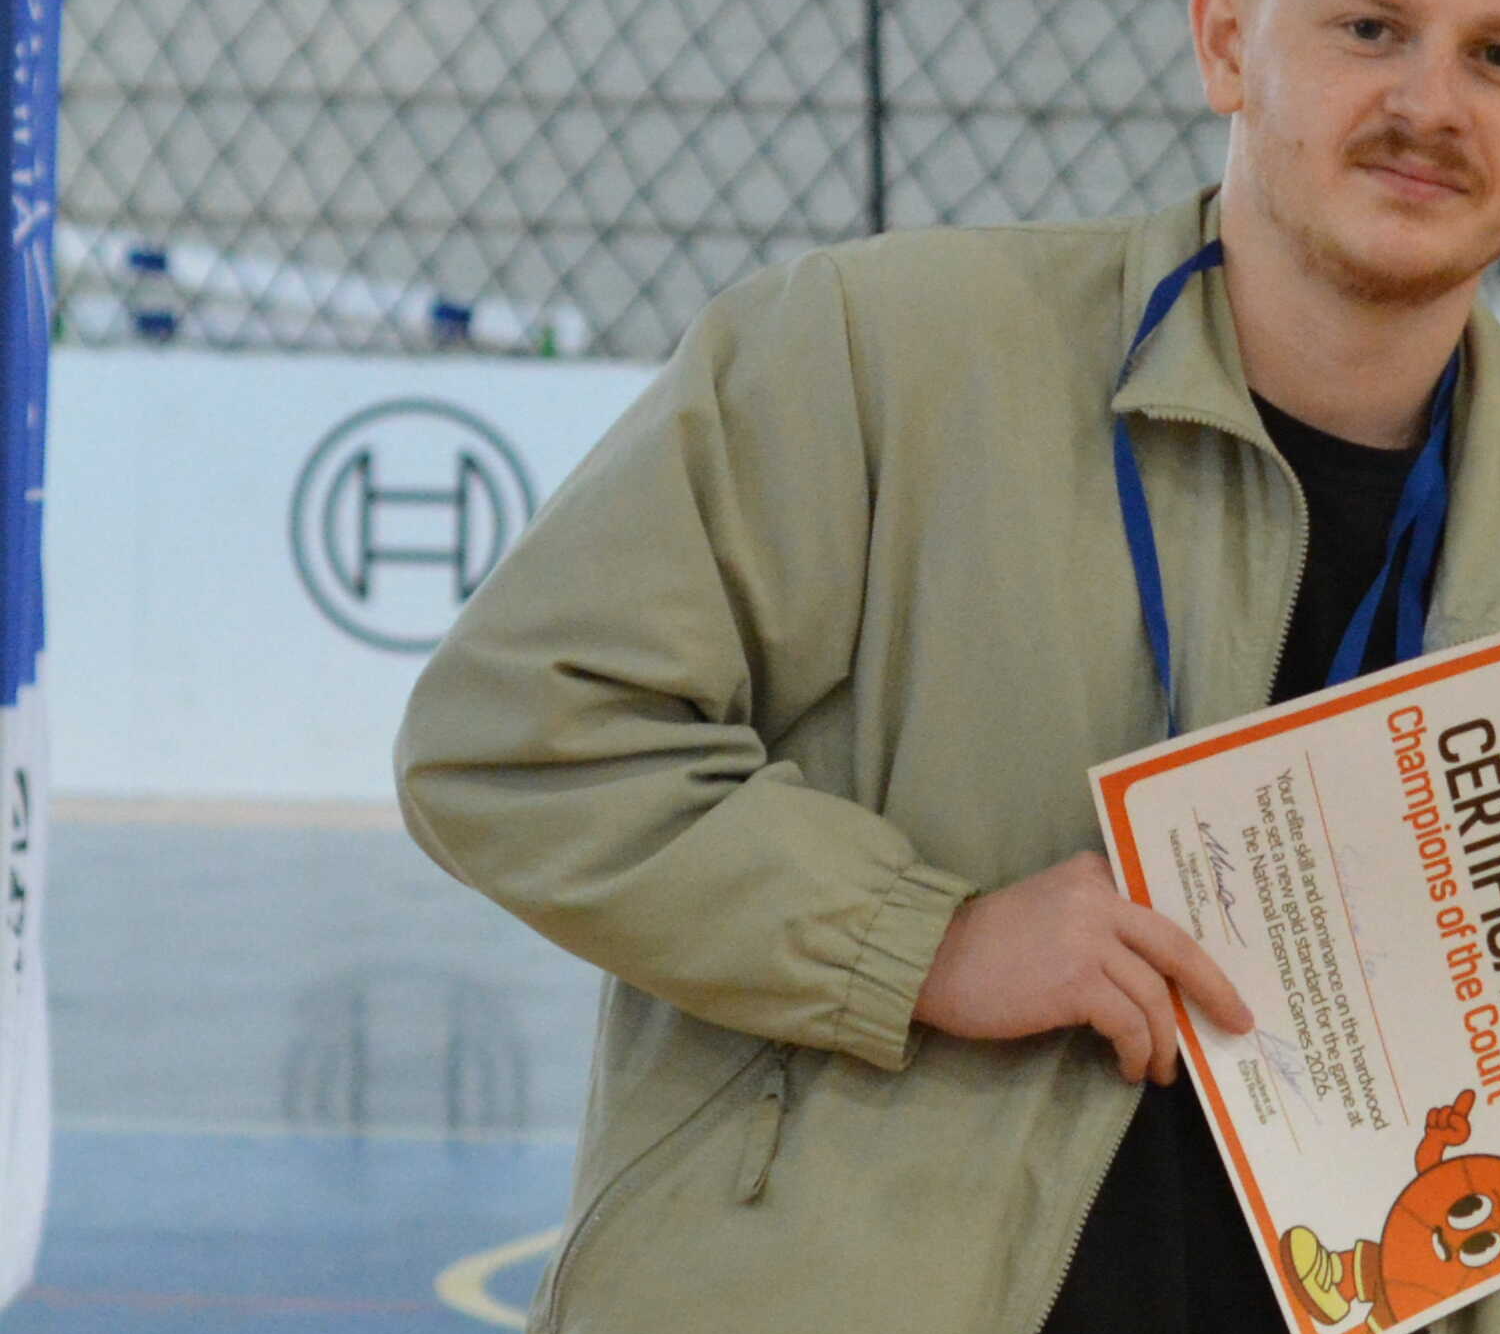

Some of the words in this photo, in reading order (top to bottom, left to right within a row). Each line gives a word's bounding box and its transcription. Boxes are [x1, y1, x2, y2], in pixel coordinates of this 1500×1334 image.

[1277, 769, 1296, 805] Your
[1387, 705, 1457, 902] Champions
[1256, 785, 1275, 824] have
[1242, 827, 1260, 853] the
[1266, 826, 1283, 851] set
[1285, 809, 1304, 841] elite
[1272, 853, 1285, 862] a
[1294, 843, 1316, 872] skill
[1249, 854, 1281, 922] National
[1276, 864, 1294, 898] new
[1302, 875, 1323, 904] and
[1281, 901, 1308, 935] gold
[1437, 906, 1477, 939] of
[1268, 923, 1295, 991] Erasmus
[1310, 905, 1343, 992] dominance
[1295, 937, 1328, 1006] standard
[1447, 942, 1483, 1002] the
[1288, 991, 1313, 1050] Games
[1315, 1006, 1332, 1029] for
[1335, 994, 1350, 1016] on
[1323, 1032, 1340, 1060] the
[1342, 1017, 1359, 1046] the
[1304, 1050, 1332, 1100] 2026.
[1328, 1062, 1356, 1107] game
[1350, 1045, 1390, 1130] hardwood
[1347, 1111, 1364, 1127] at
